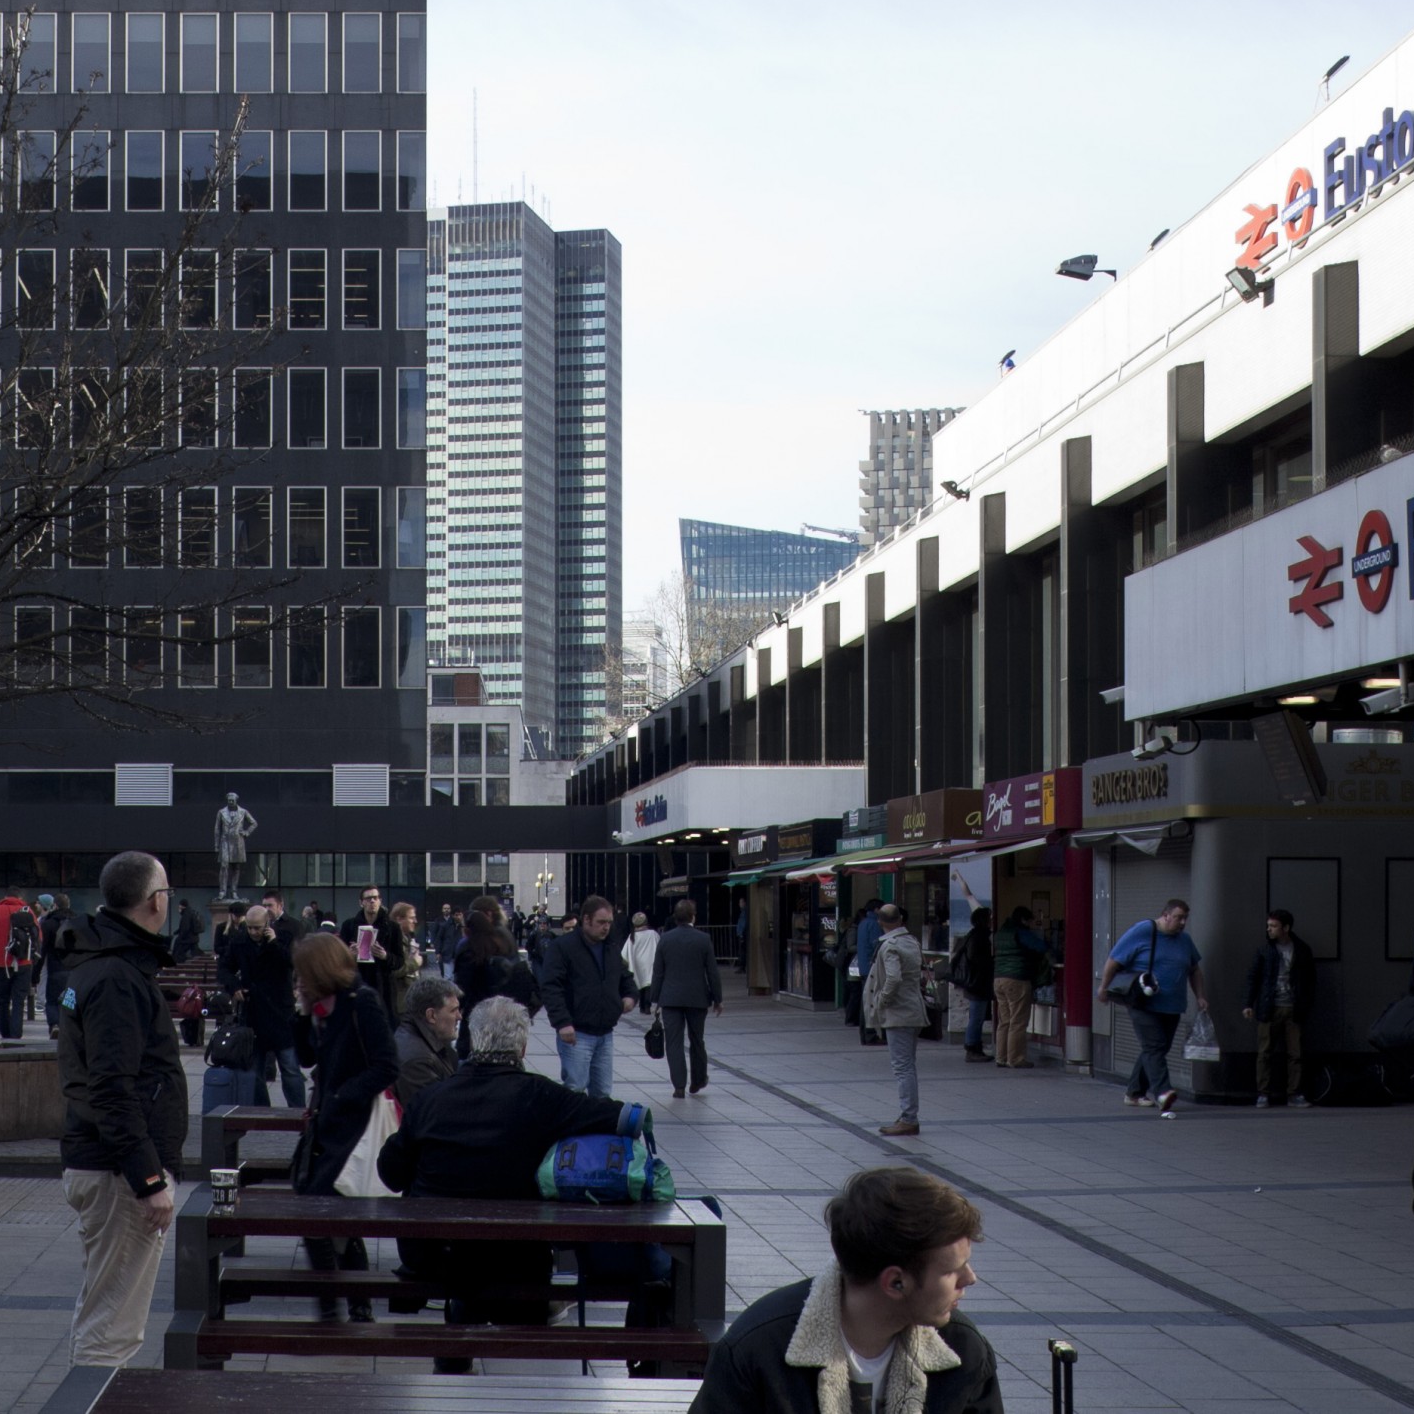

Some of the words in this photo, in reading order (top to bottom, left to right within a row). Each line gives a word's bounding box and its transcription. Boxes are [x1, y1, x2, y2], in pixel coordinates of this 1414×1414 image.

[1353, 549, 1392, 573] UNDERGROUND
[1091, 769, 1137, 807] BANGER
[1326, 779, 1390, 803] GER
